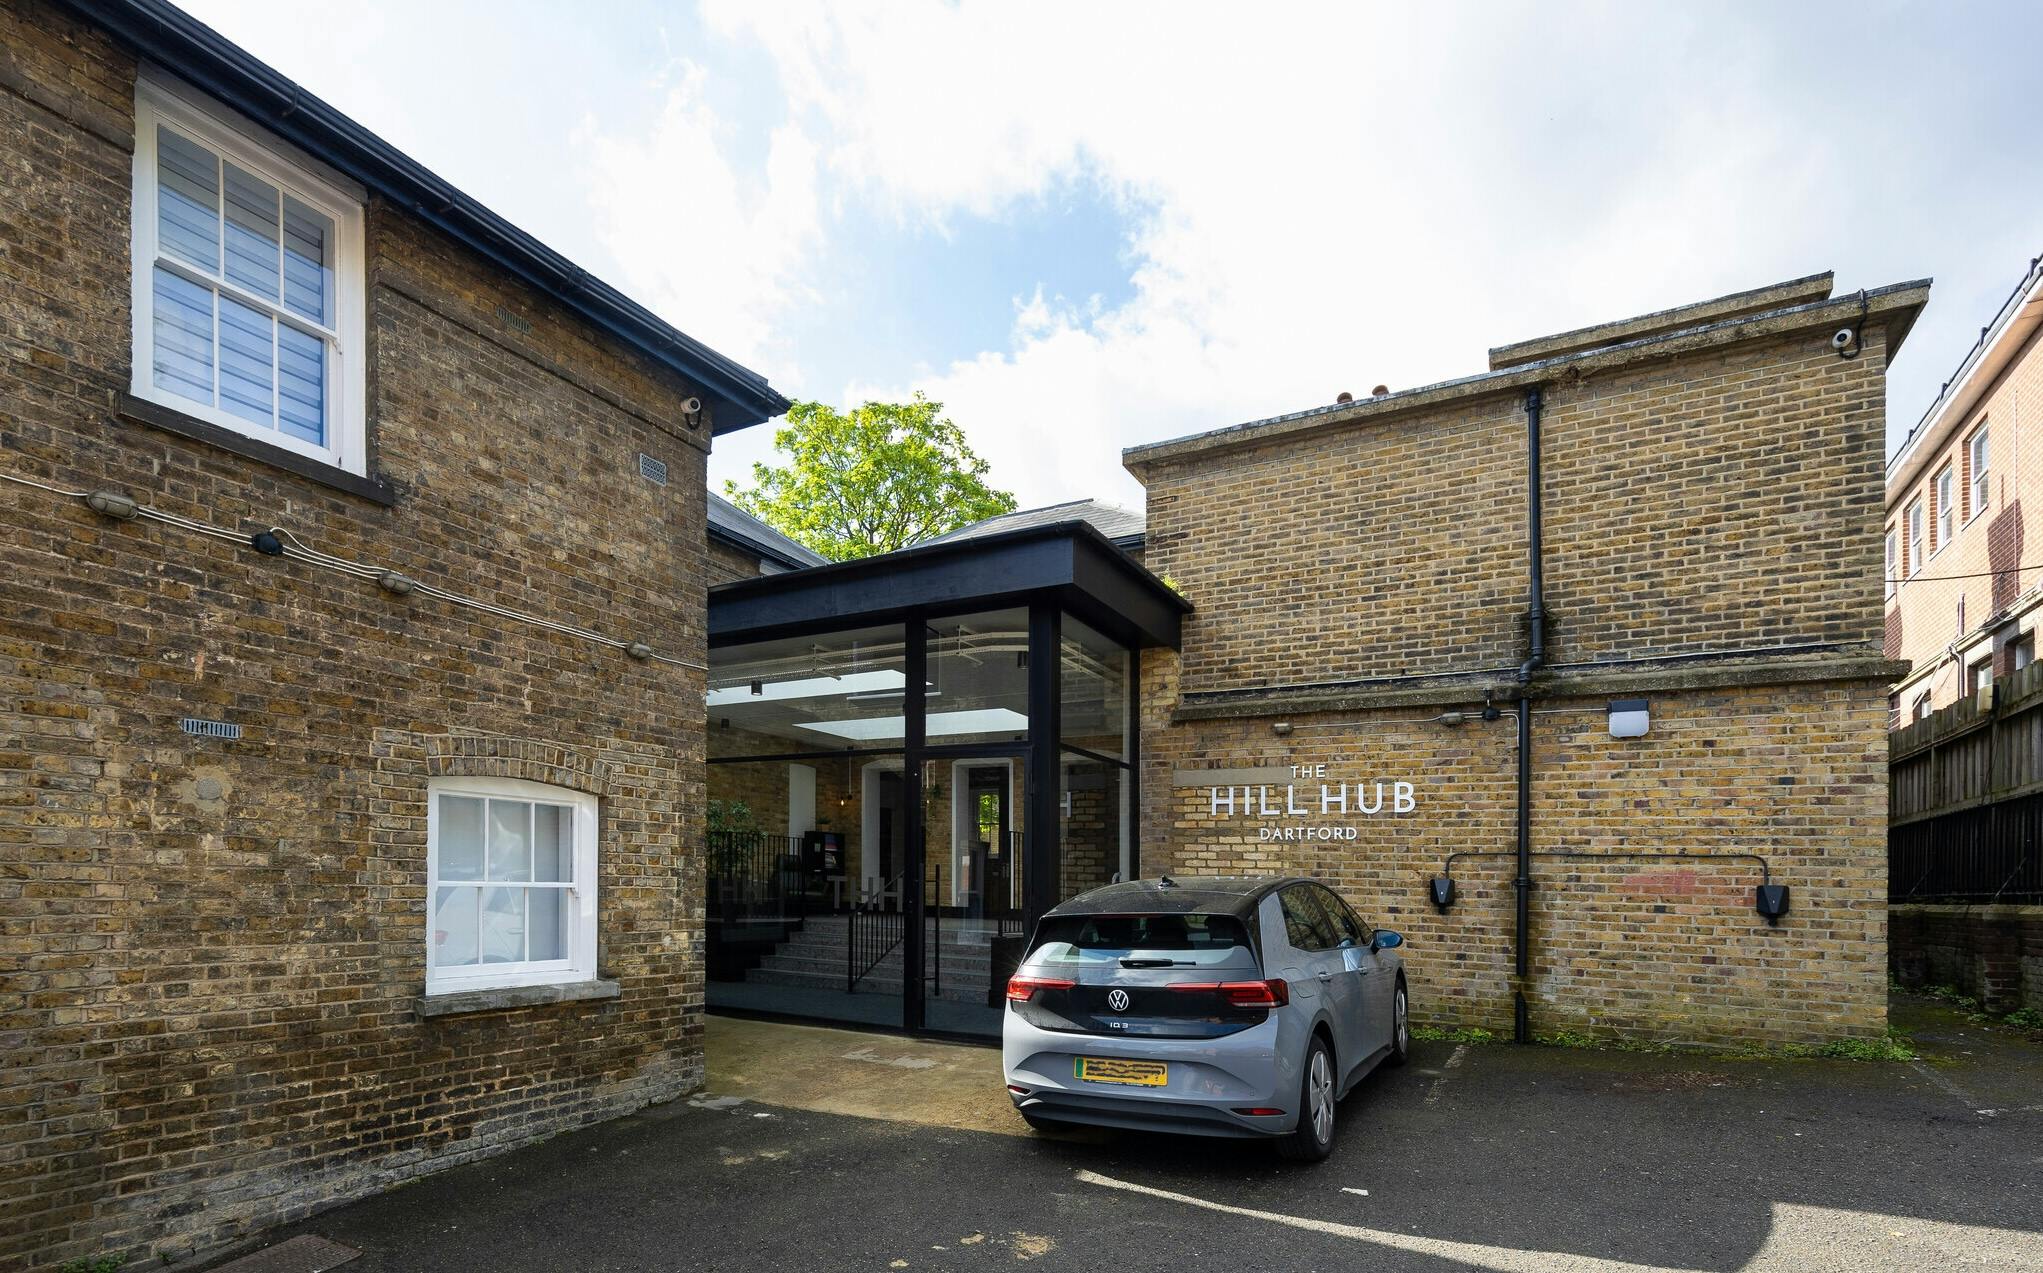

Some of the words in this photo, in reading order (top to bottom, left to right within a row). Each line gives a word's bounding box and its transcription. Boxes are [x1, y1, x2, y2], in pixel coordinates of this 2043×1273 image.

[1290, 764, 1326, 779] THE
[1211, 784, 1308, 816] HILL
[1321, 781, 1416, 815] HUB
[1260, 827, 1357, 840] DARTFORD
